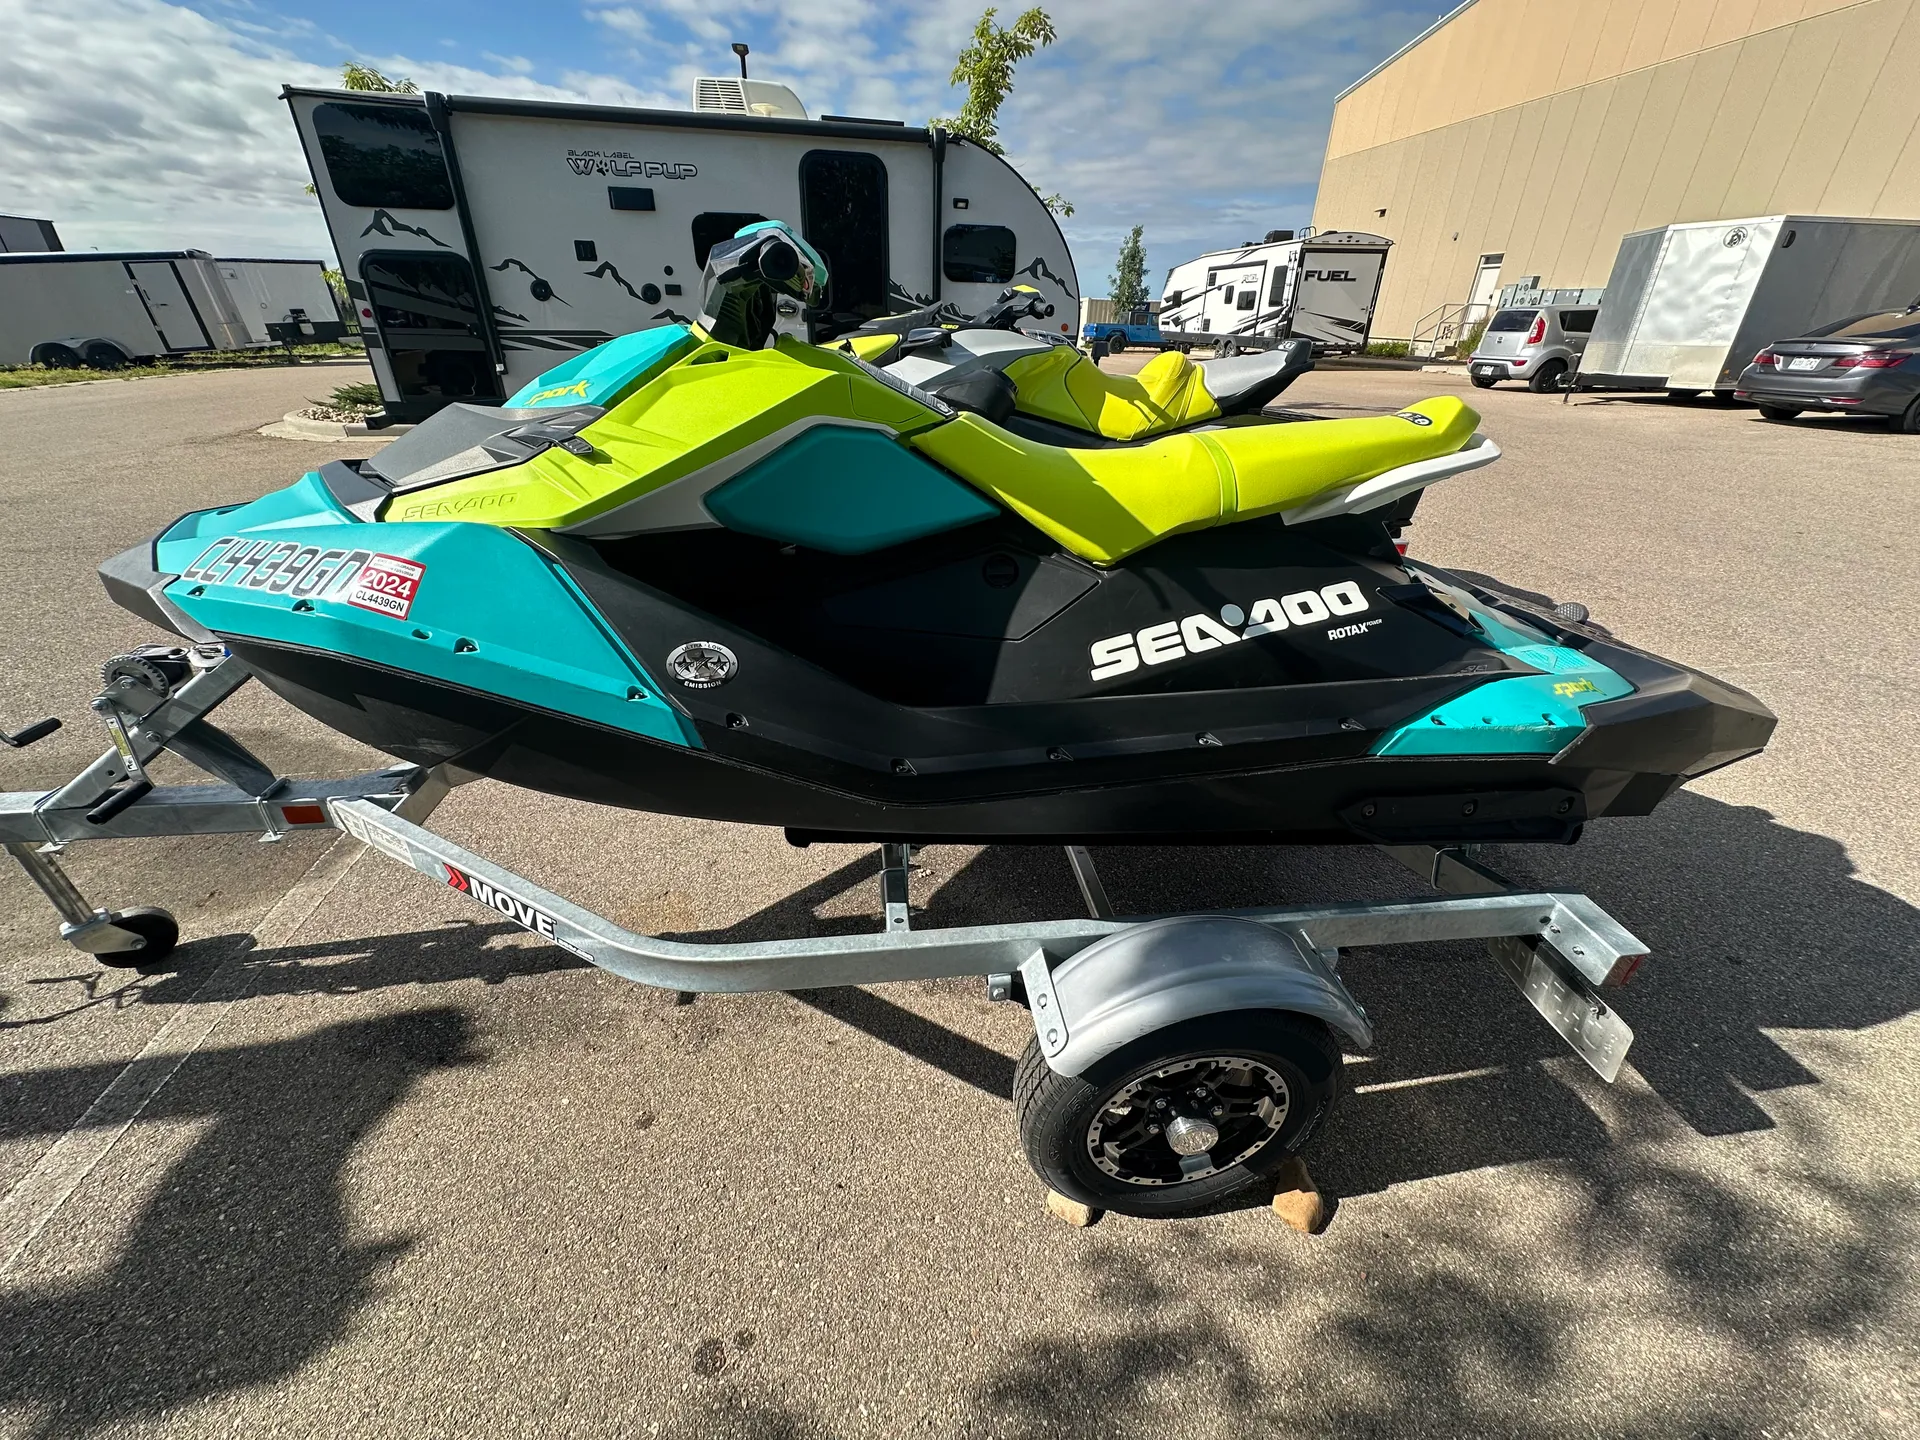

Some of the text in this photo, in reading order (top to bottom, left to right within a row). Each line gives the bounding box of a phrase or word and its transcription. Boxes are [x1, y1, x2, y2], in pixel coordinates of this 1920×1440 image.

[603, 151, 634, 159] LABEL
[644, 161, 698, 180] PUP
[1303, 270, 1356, 282] FUEL
[359, 569, 413, 598] 2024
[355, 590, 405, 612] CL4439GN
[1327, 622, 1369, 641] ROTAX
[707, 643, 723, 651] LOW
[684, 680, 722, 689] EMISSION
[468, 876, 555, 940] MOVE
